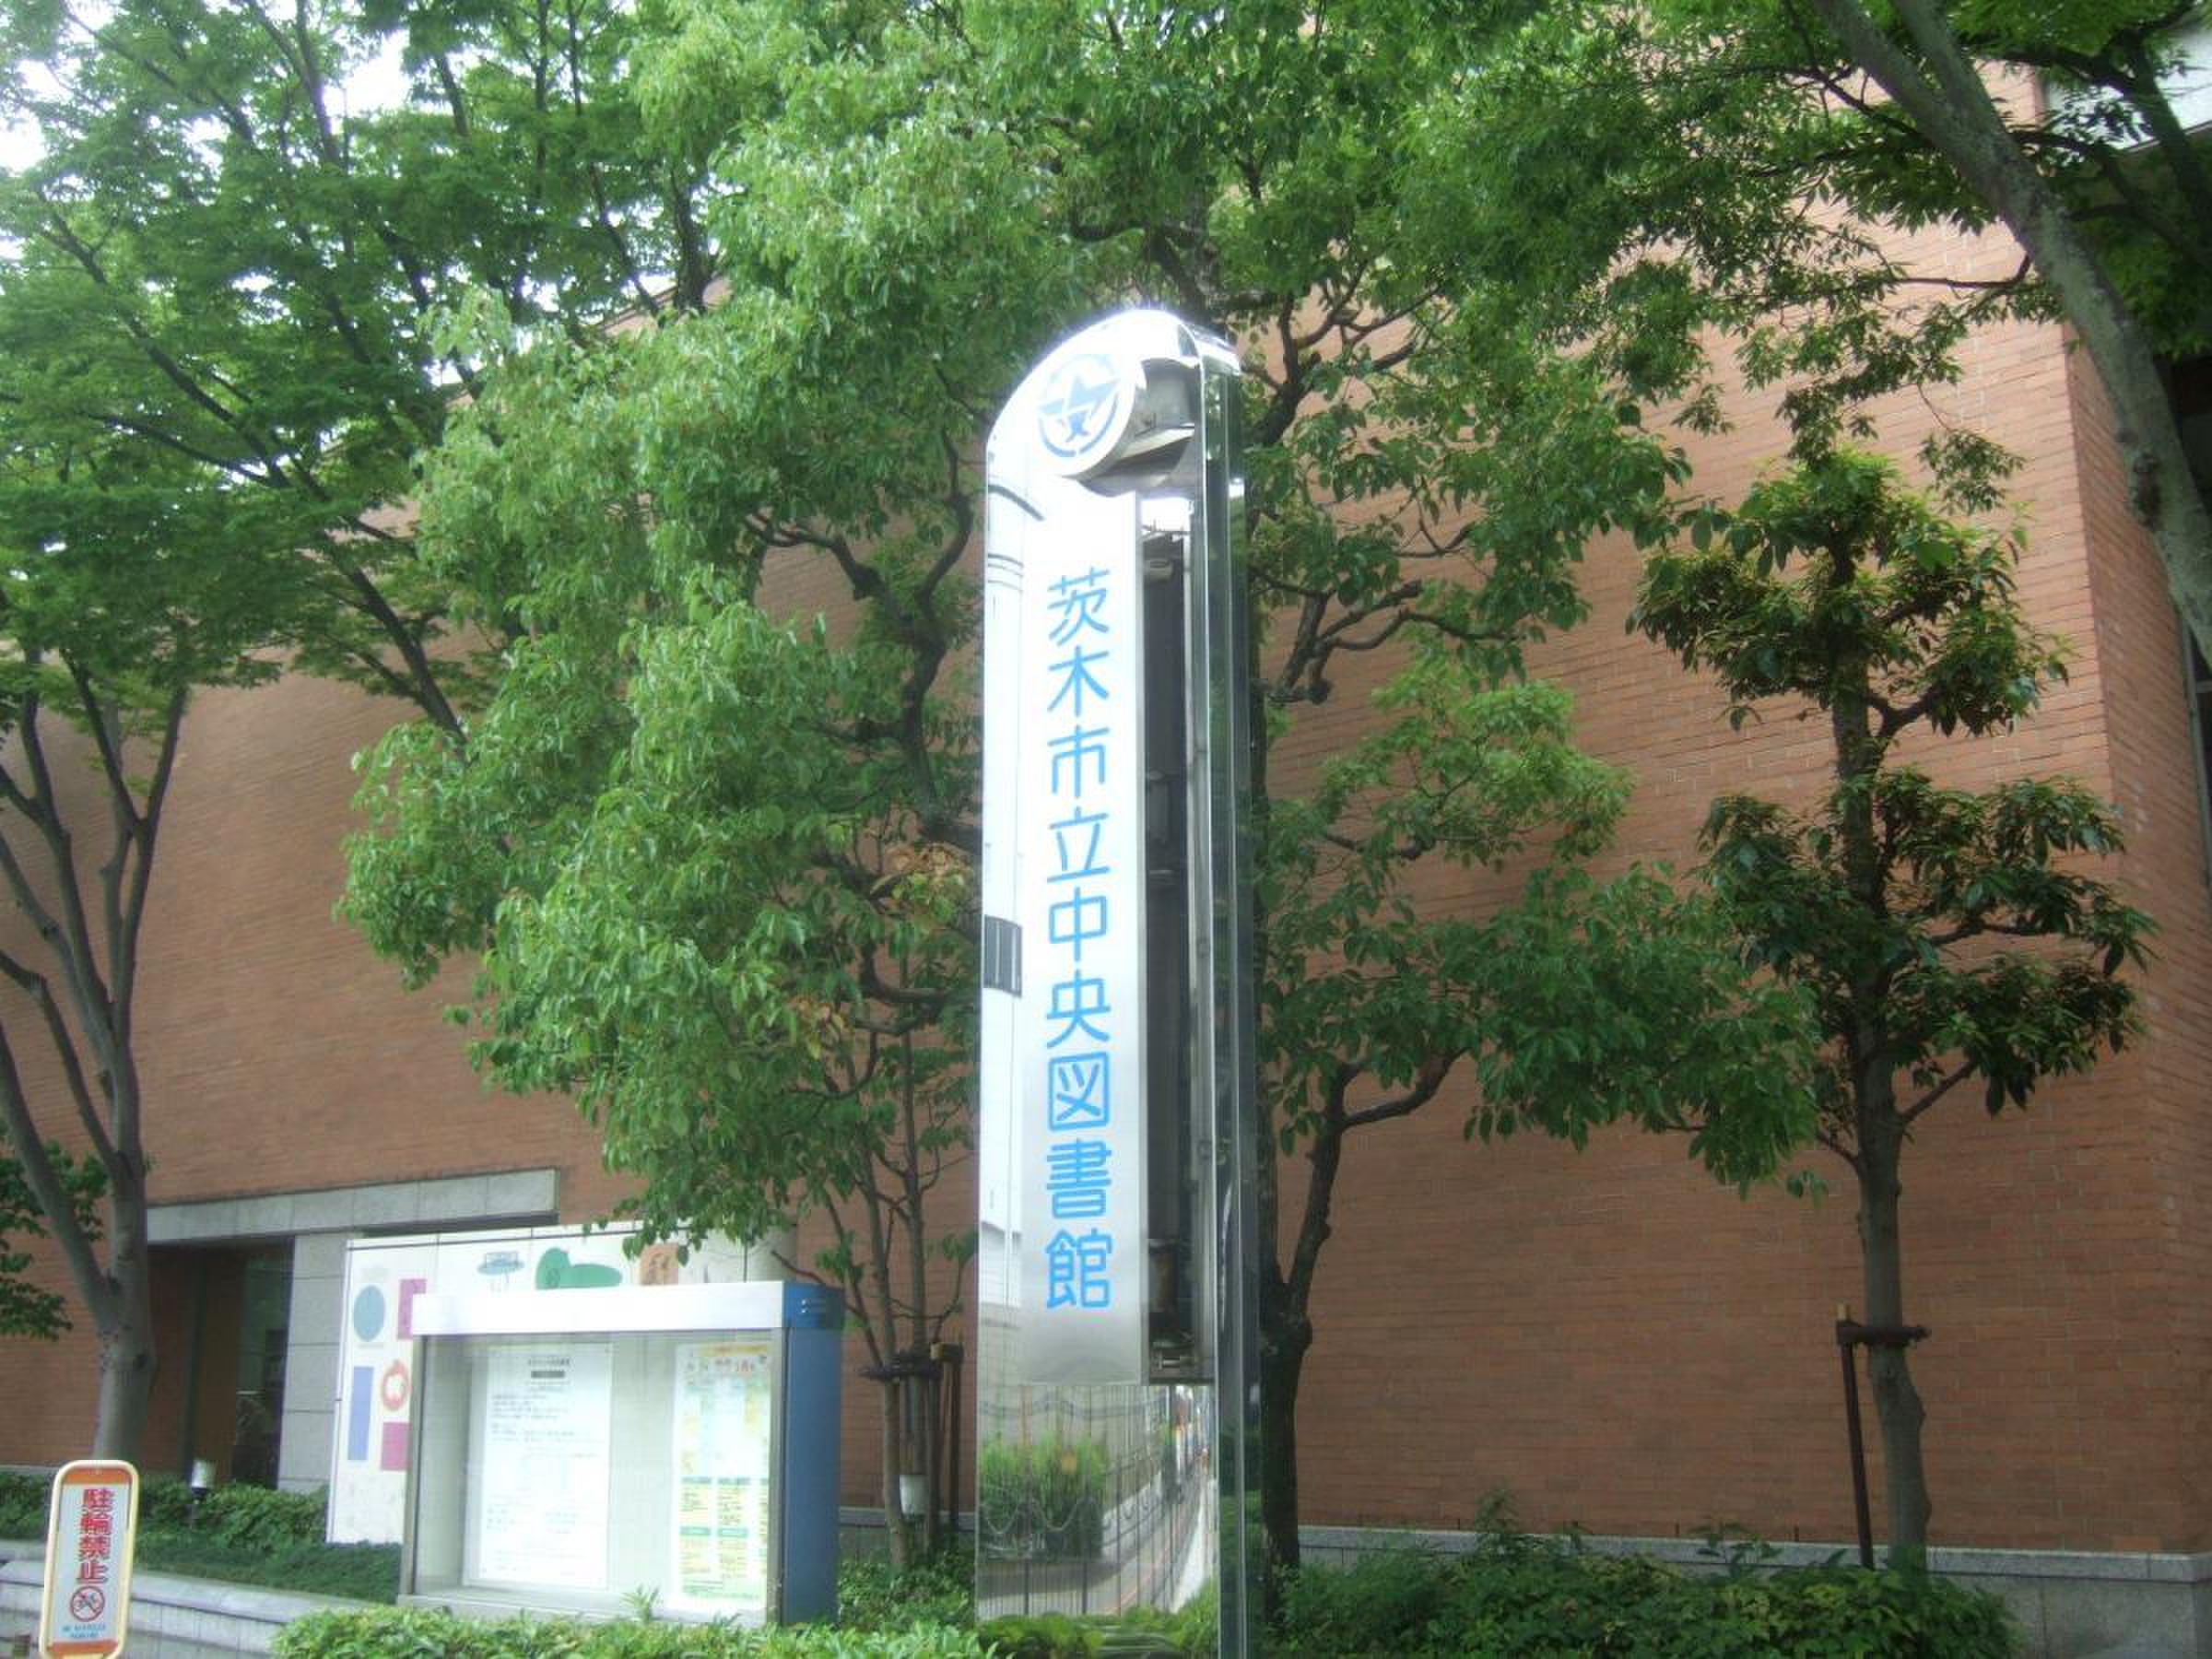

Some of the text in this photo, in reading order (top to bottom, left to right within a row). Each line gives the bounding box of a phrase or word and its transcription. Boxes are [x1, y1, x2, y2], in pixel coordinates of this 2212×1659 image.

[1045, 566, 1112, 1310] 茨木市立中央図書館
[76, 1488, 116, 1583] 駐輪禁止
